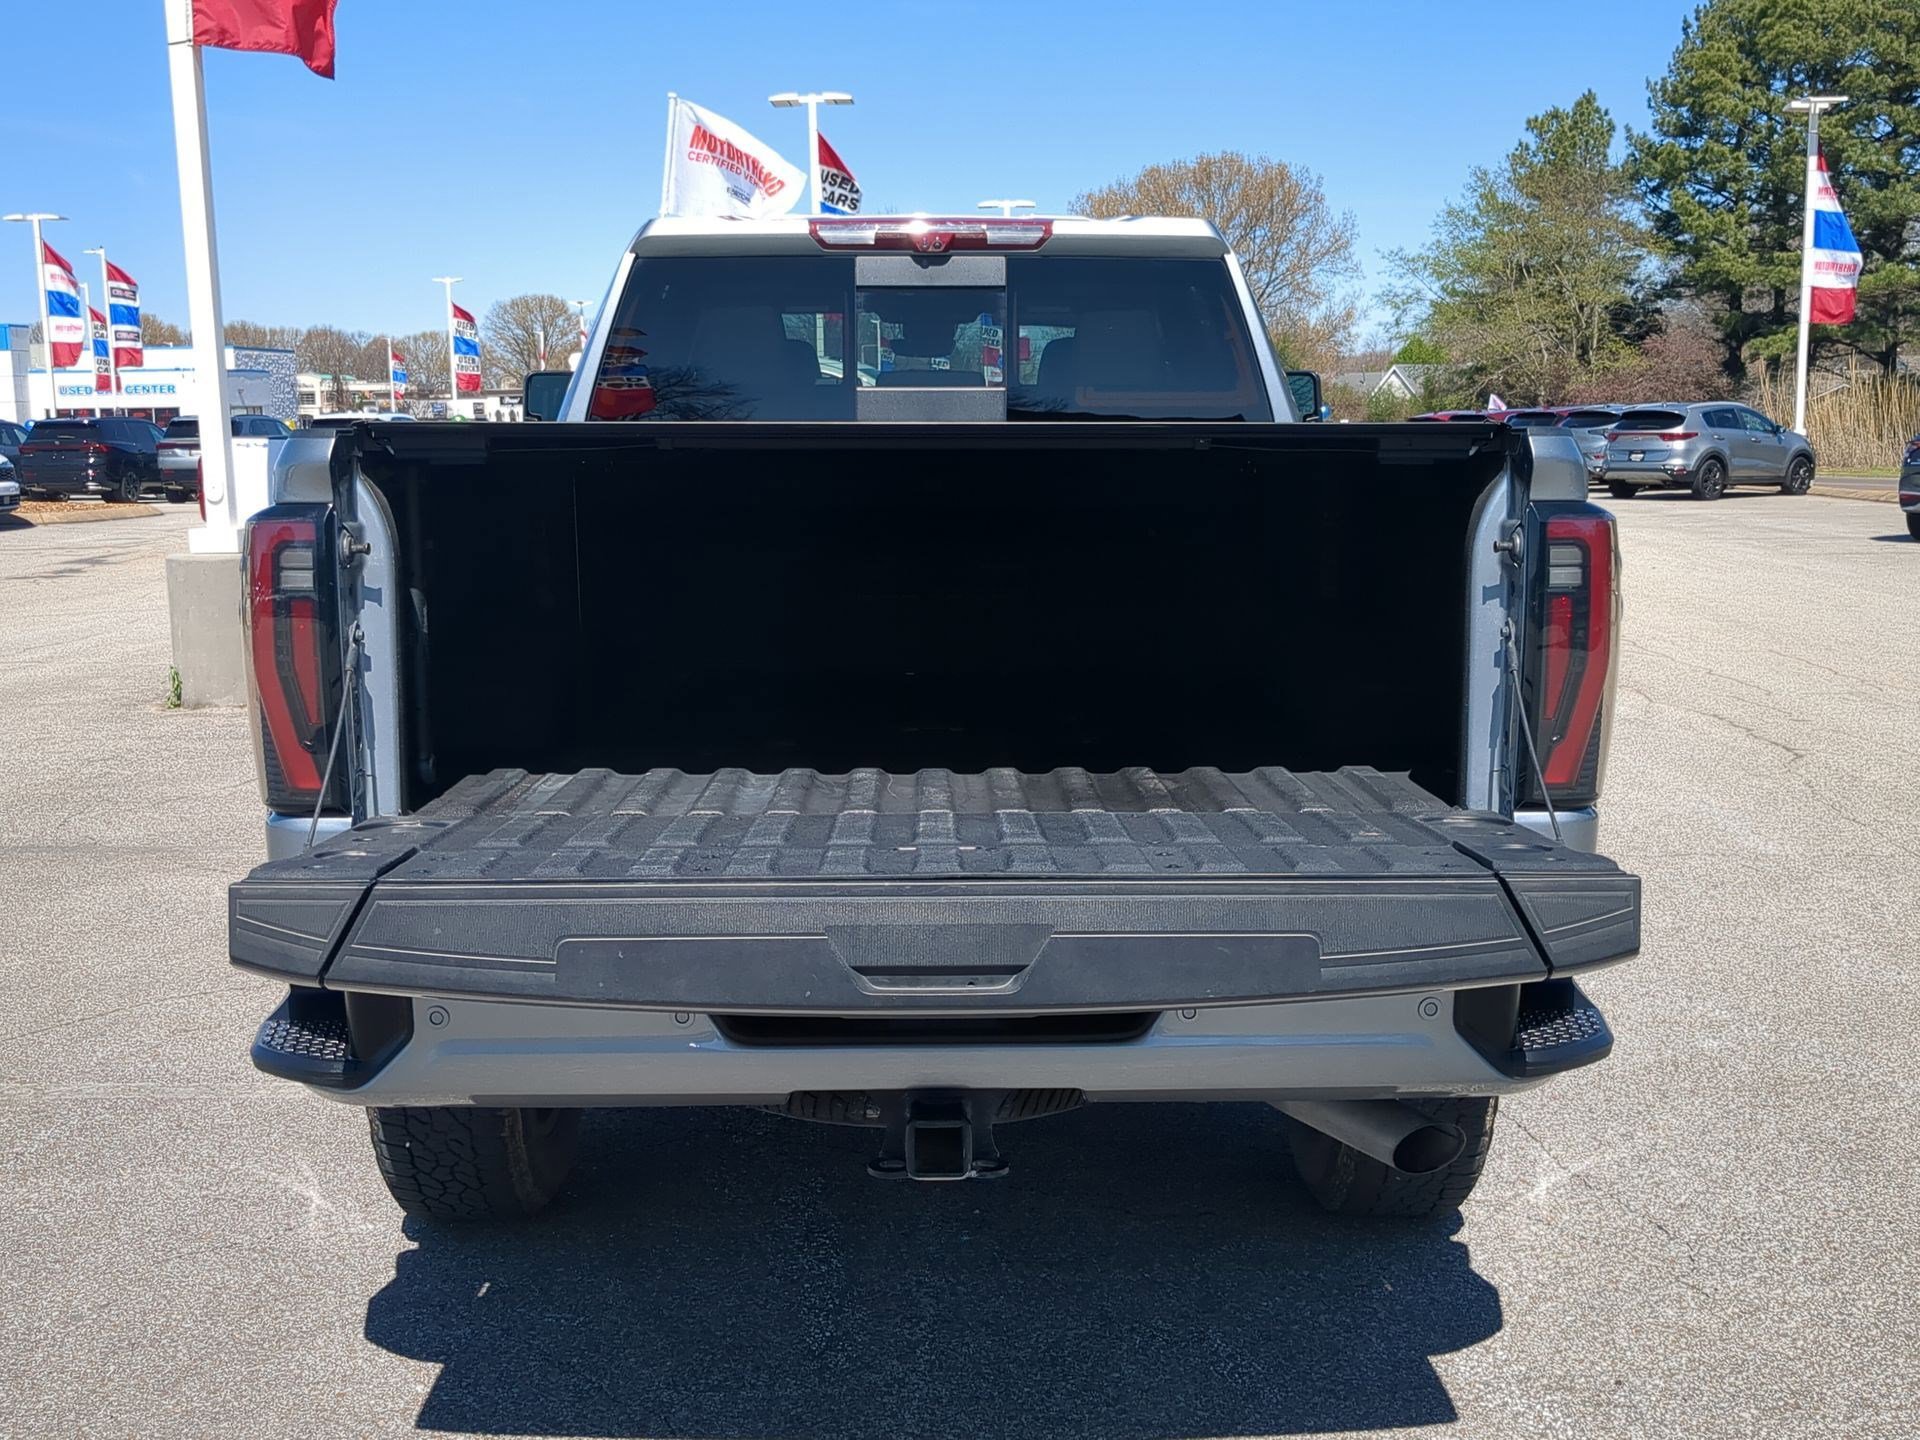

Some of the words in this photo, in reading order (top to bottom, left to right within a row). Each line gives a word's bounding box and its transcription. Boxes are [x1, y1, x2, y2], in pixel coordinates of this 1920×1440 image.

[688, 151, 742, 175] CERTIFIED
[689, 124, 785, 197] MOTORTREND
[820, 169, 860, 193] USED
[822, 187, 860, 211] CARS
[456, 320, 475, 331] USED
[58, 385, 93, 395] USED
[124, 384, 176, 394] CENTER
